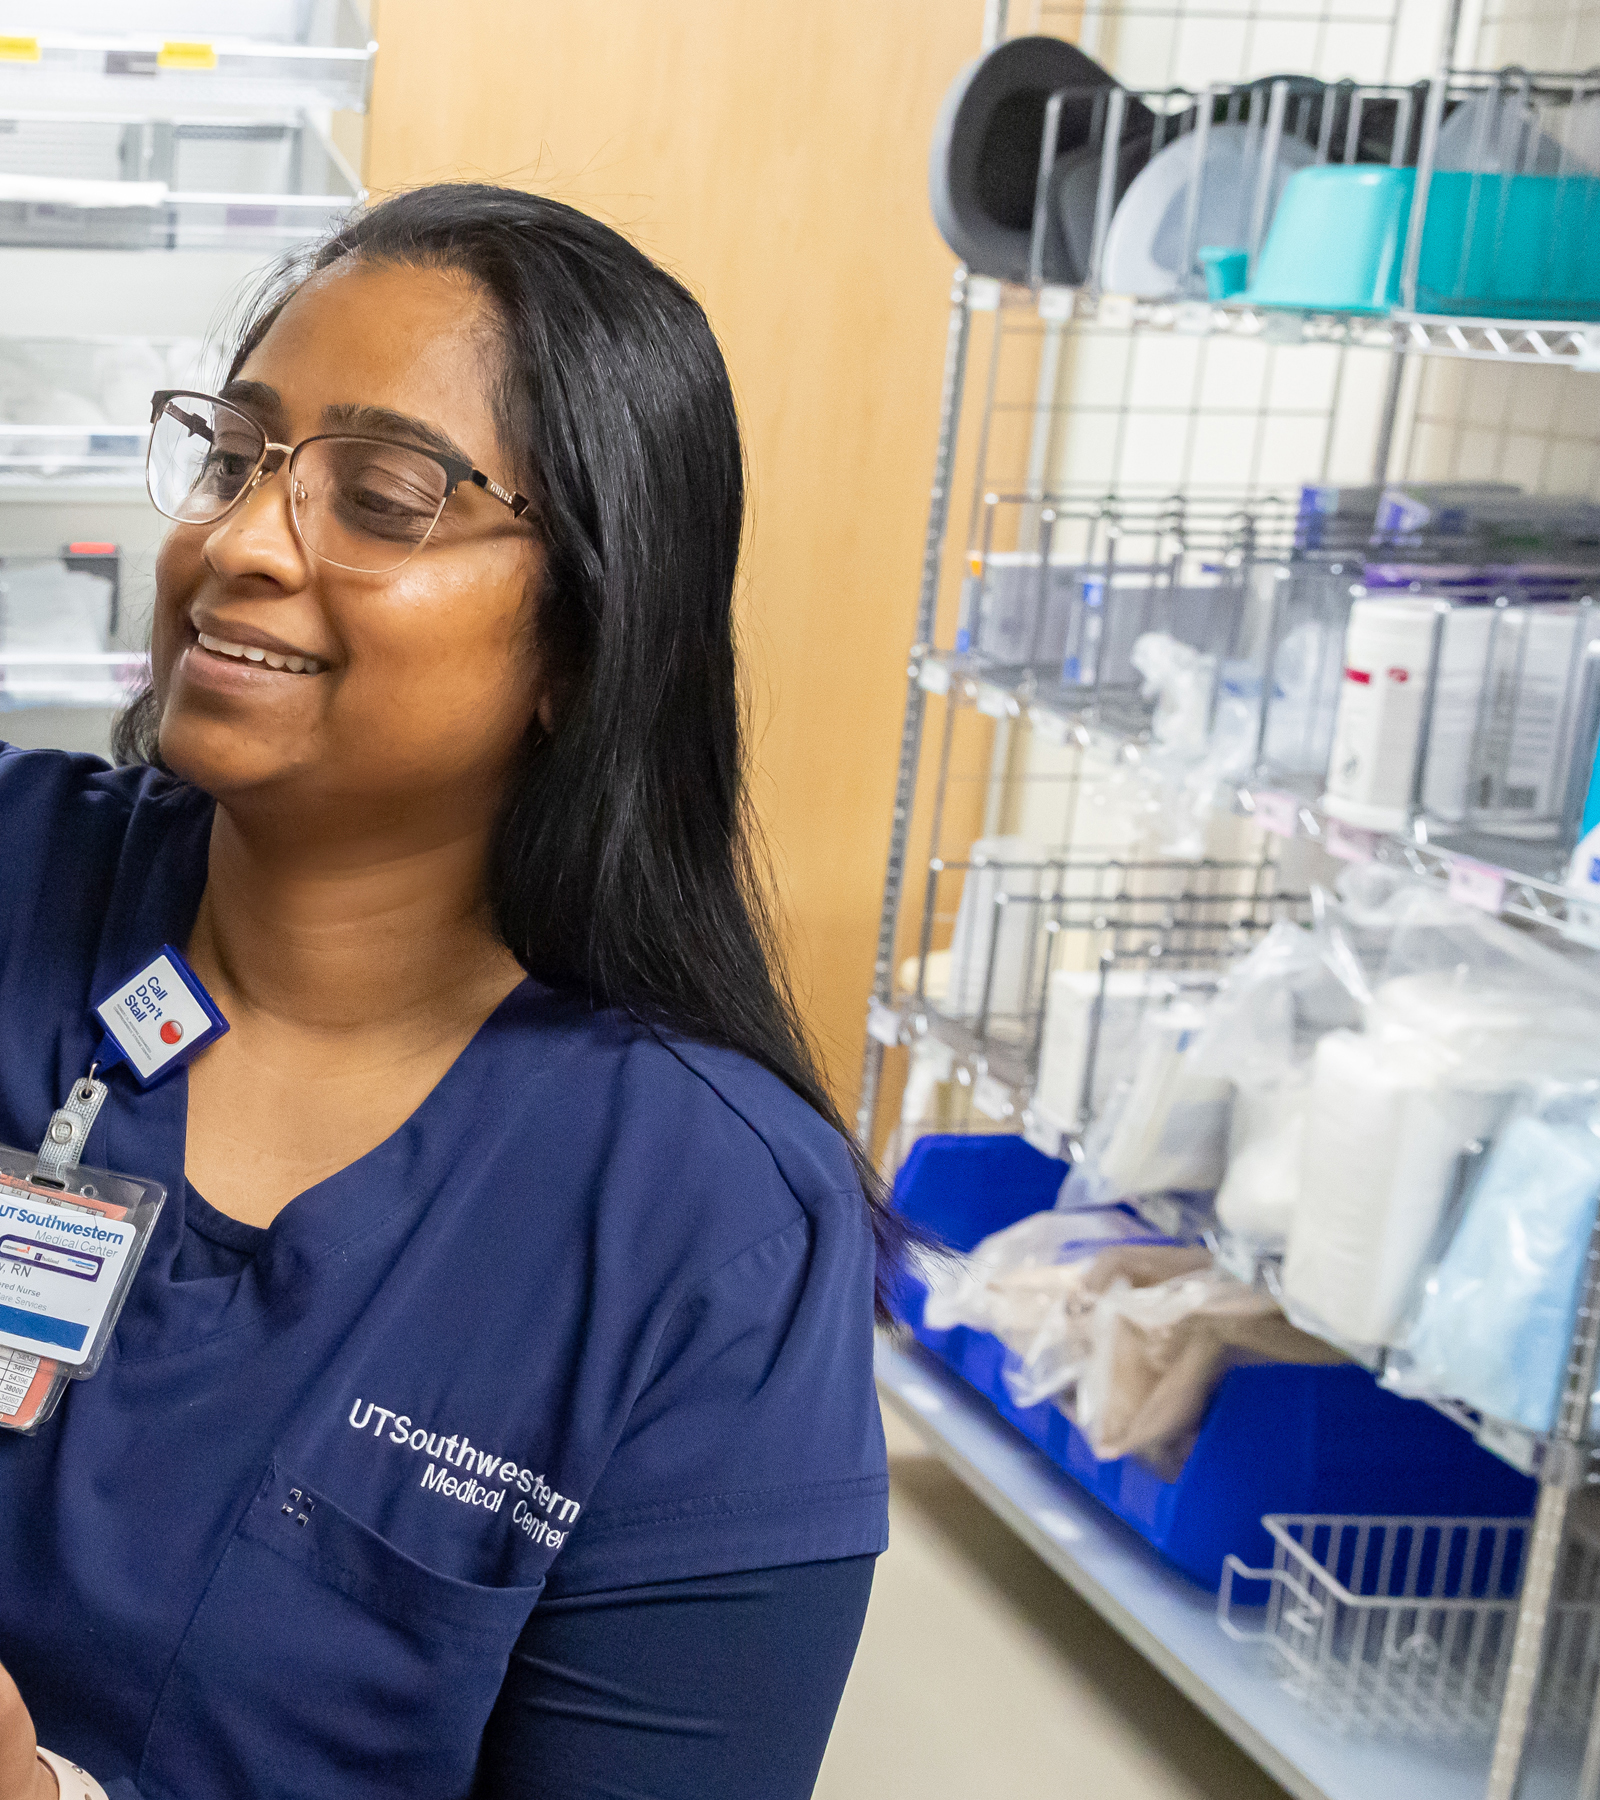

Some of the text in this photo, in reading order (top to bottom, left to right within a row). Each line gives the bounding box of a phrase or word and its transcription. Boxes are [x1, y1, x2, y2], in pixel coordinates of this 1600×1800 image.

[147, 976, 168, 1001] Call
[124, 994, 148, 1022] Stall
[135, 984, 163, 1020] Don't
[35, 1230, 118, 1258] Medical Center
[11, 1263, 31, 1278] RN
[15, 1297, 47, 1311] Services
[18, 1285, 40, 1297] Nurse
[421, 1463, 570, 1549] Medical Center
